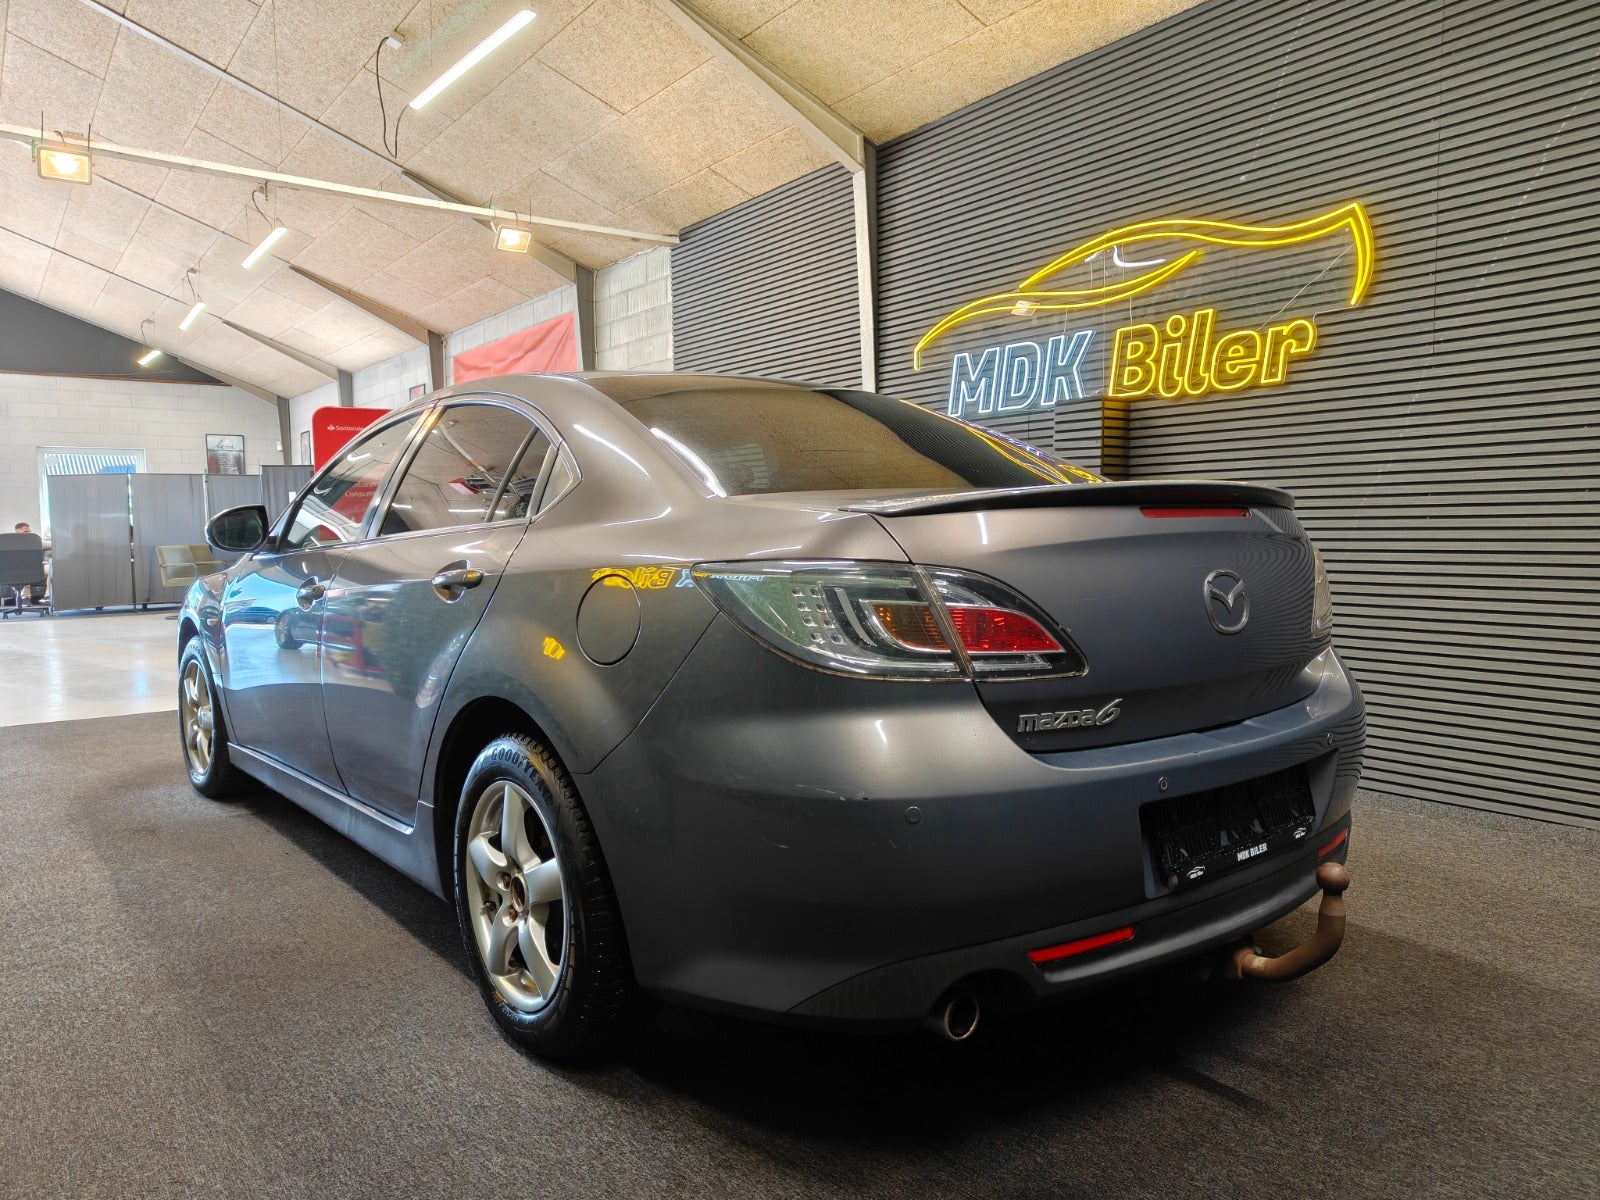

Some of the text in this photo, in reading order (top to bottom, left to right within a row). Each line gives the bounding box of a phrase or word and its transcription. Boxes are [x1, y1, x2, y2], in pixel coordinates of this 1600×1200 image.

[947, 308, 1318, 419] MDK Biler
[1250, 843, 1268, 857] BILER
